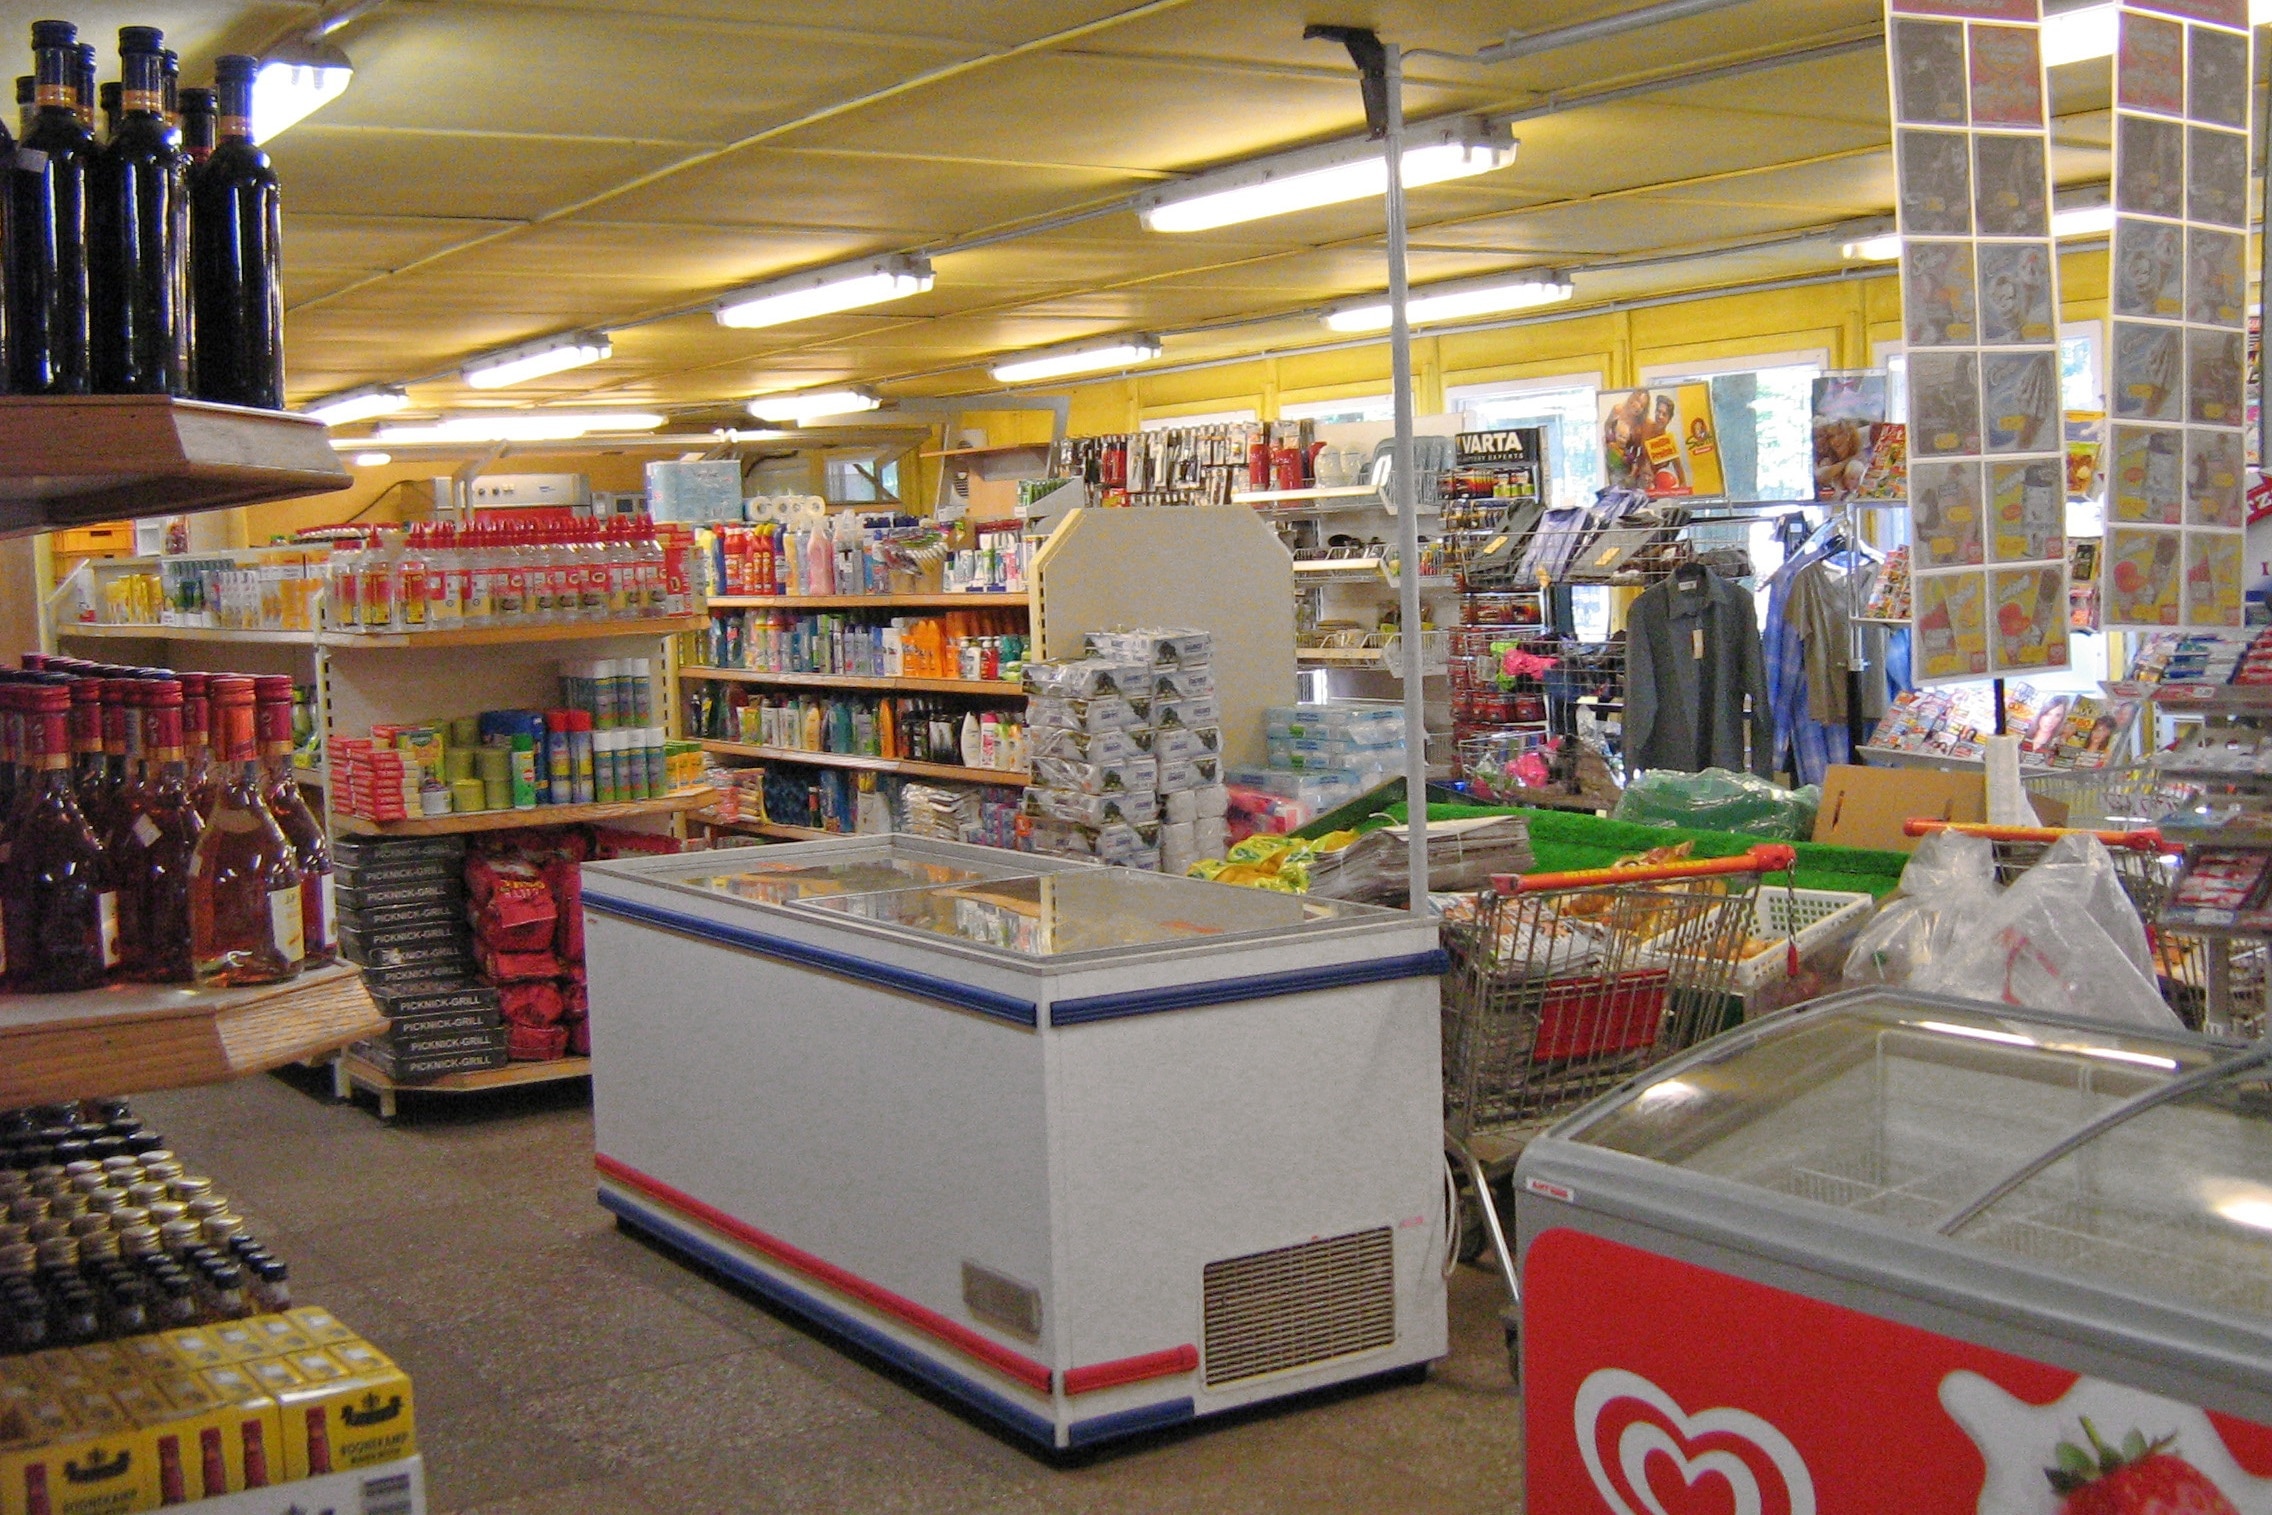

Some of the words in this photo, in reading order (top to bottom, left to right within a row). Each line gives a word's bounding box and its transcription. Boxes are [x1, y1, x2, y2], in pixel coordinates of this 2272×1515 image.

[1461, 431, 1523, 454] VARTA
[1488, 452, 1524, 461] EXPERTS
[367, 866, 447, 880] PICKNICK-GRILL
[367, 886, 447, 901] PICKNICK-GRILL
[373, 907, 453, 923] PICKNICK-GRILL
[373, 928, 453, 944] PICKNICK-GRILL
[385, 967, 462, 981] PICKNICK-GRILL
[400, 995, 481, 1011] PICKNICK-GRILL
[403, 1015, 484, 1032] PICKNICK-GRILL
[411, 1036, 492, 1052] PICKNICK-GRILL
[410, 1056, 492, 1072] PICKNICK-GRILL
